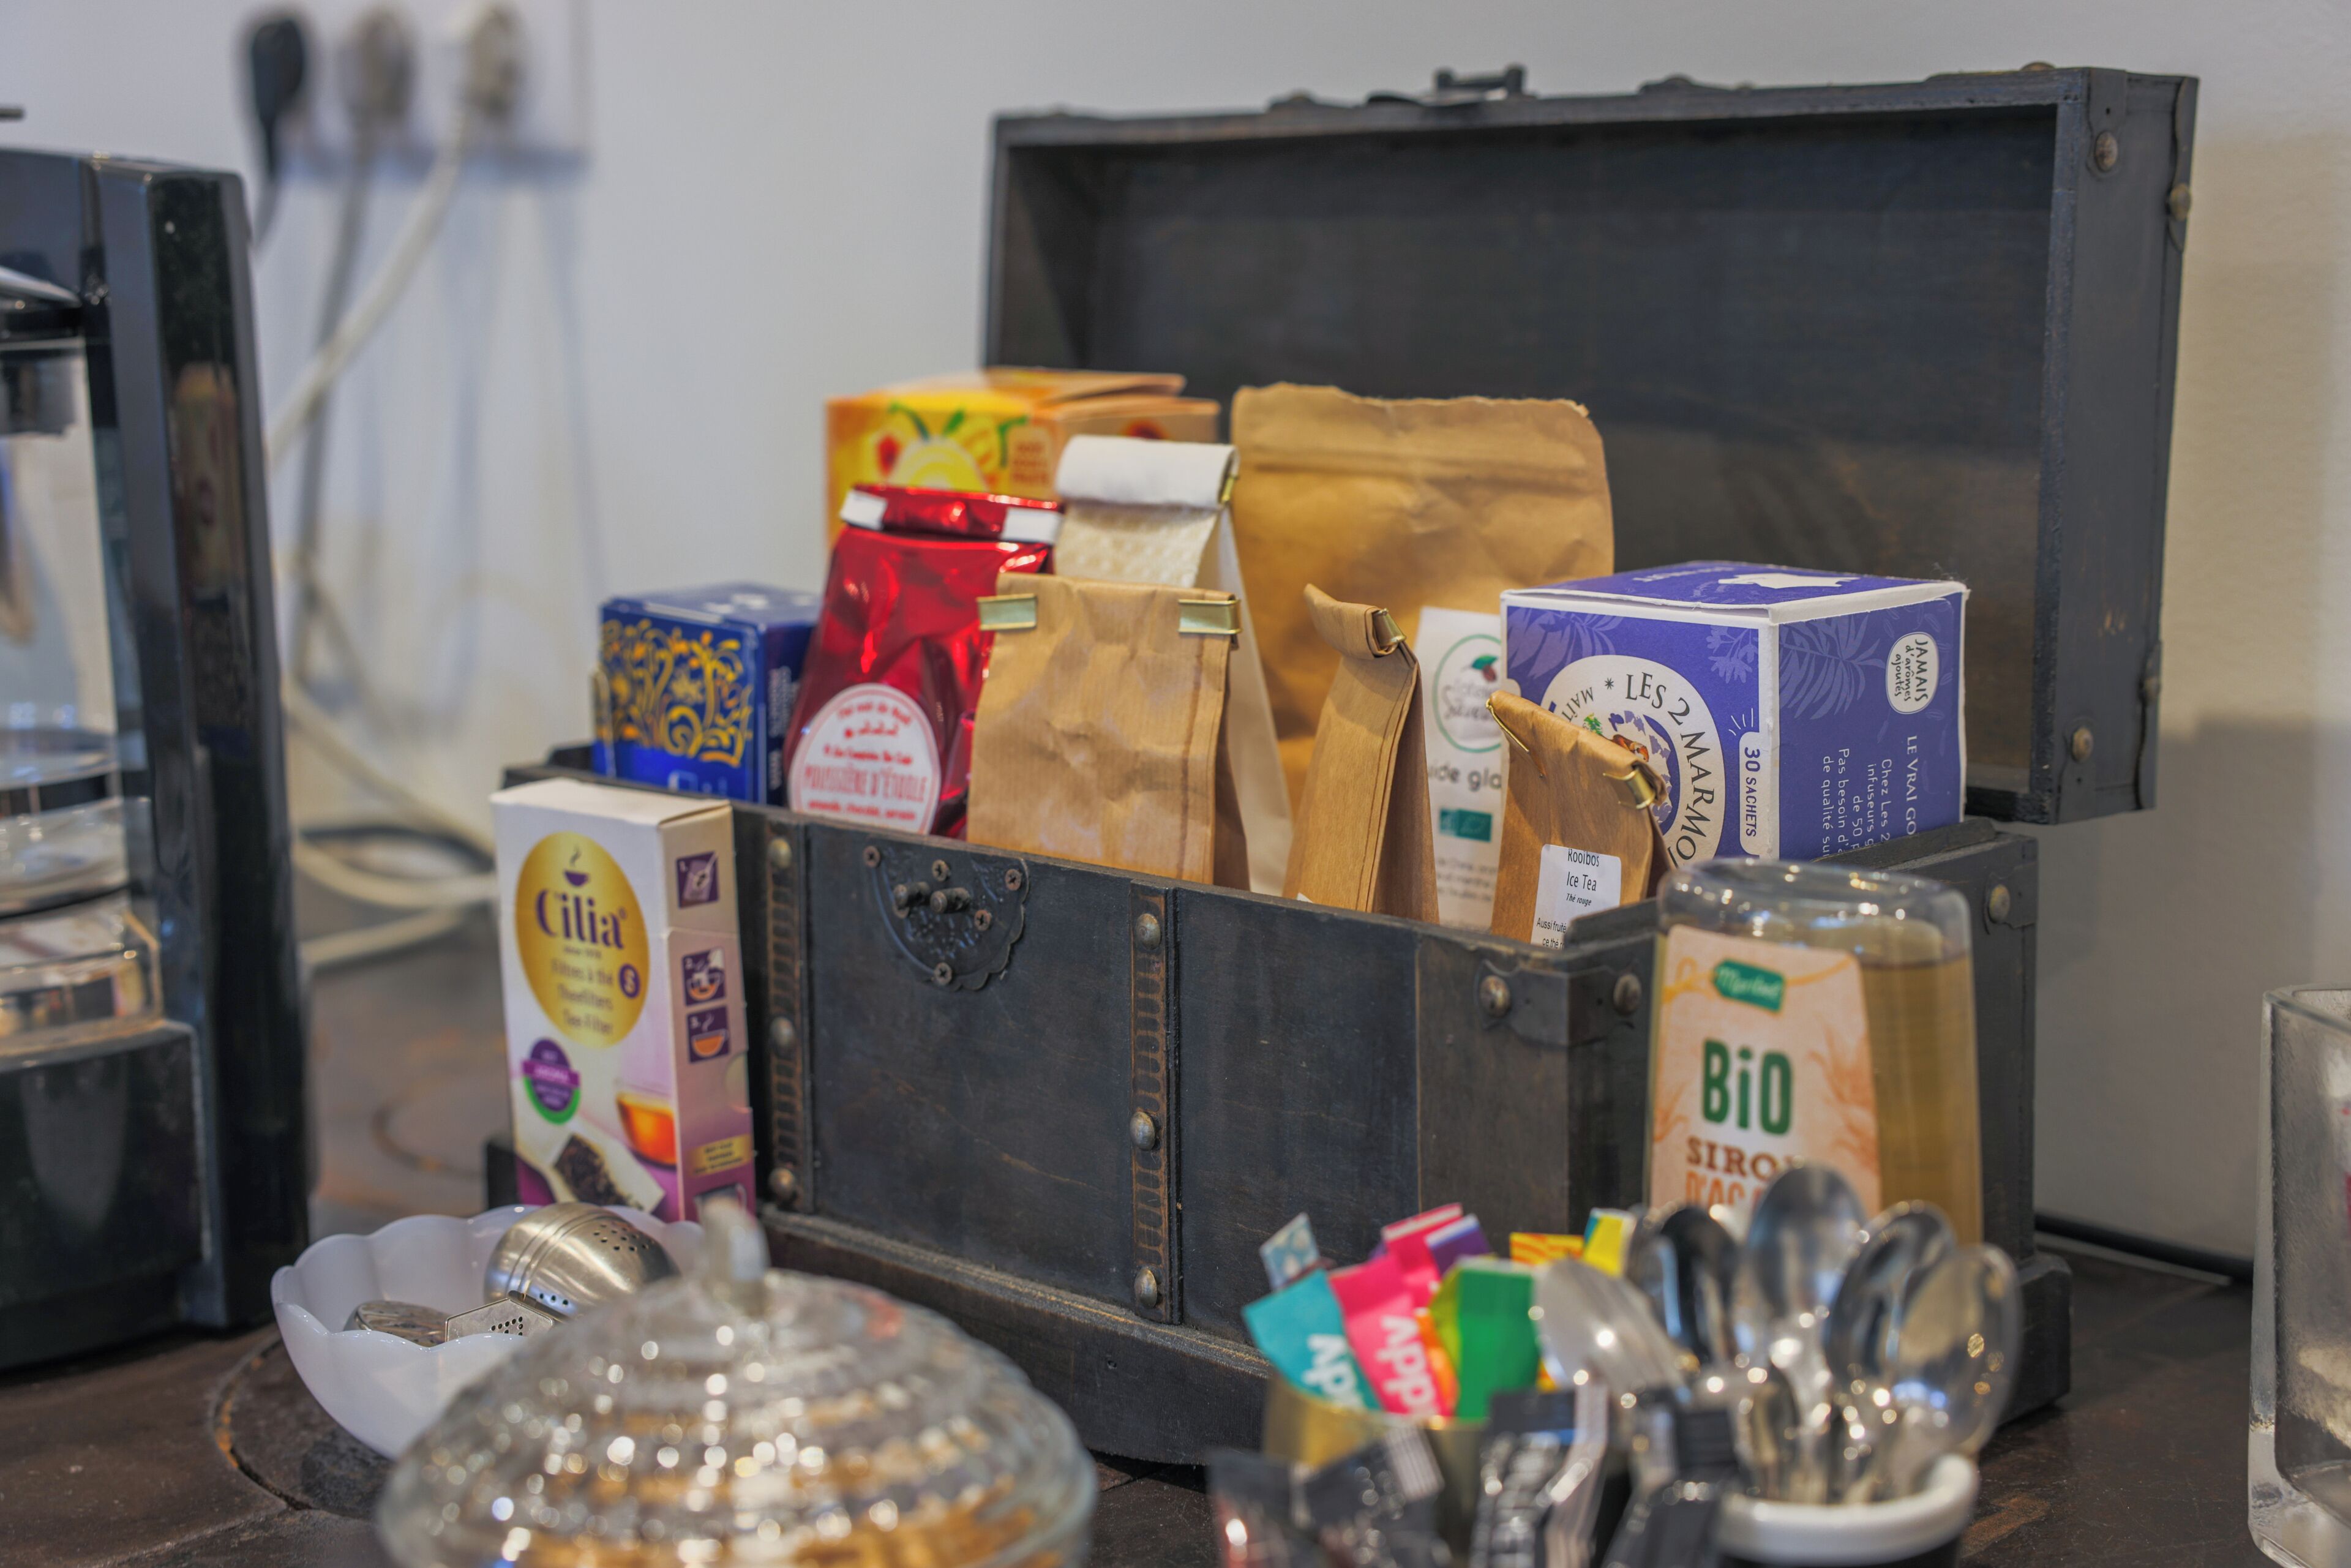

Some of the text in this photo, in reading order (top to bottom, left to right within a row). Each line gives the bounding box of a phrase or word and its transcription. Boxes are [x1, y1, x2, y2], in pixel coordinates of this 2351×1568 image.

[1891, 653, 1905, 697] ajoutés
[1904, 645, 1915, 702] d'arômes
[1914, 639, 1929, 702] JAMAIS
[1625, 672, 1667, 709] LES
[1668, 697, 1690, 726] 2
[1823, 756, 1835, 773] de
[1839, 748, 1850, 775] Pas
[1905, 735, 1918, 835] LE VRAI GO
[1744, 747, 1761, 837] 30 SACHETS
[1821, 779, 1834, 830] qualité
[1838, 779, 1850, 828] besoin
[1853, 795, 1864, 812] de
[1867, 763, 1878, 832] infuseurs
[1880, 759, 1892, 842] Chez Les 2
[1852, 818, 1863, 837] 50
[1566, 871, 1597, 891] Ice Tea
[1567, 849, 1600, 868] Rooibos
[535, 889, 624, 950] Cilia
[1566, 893, 1592, 907] Thé rouge
[1536, 917, 1553, 931] Aussi
[1542, 938, 1550, 947] ce
[1550, 938, 1559, 950] thé
[1685, 1136, 1794, 1183] SIRO
